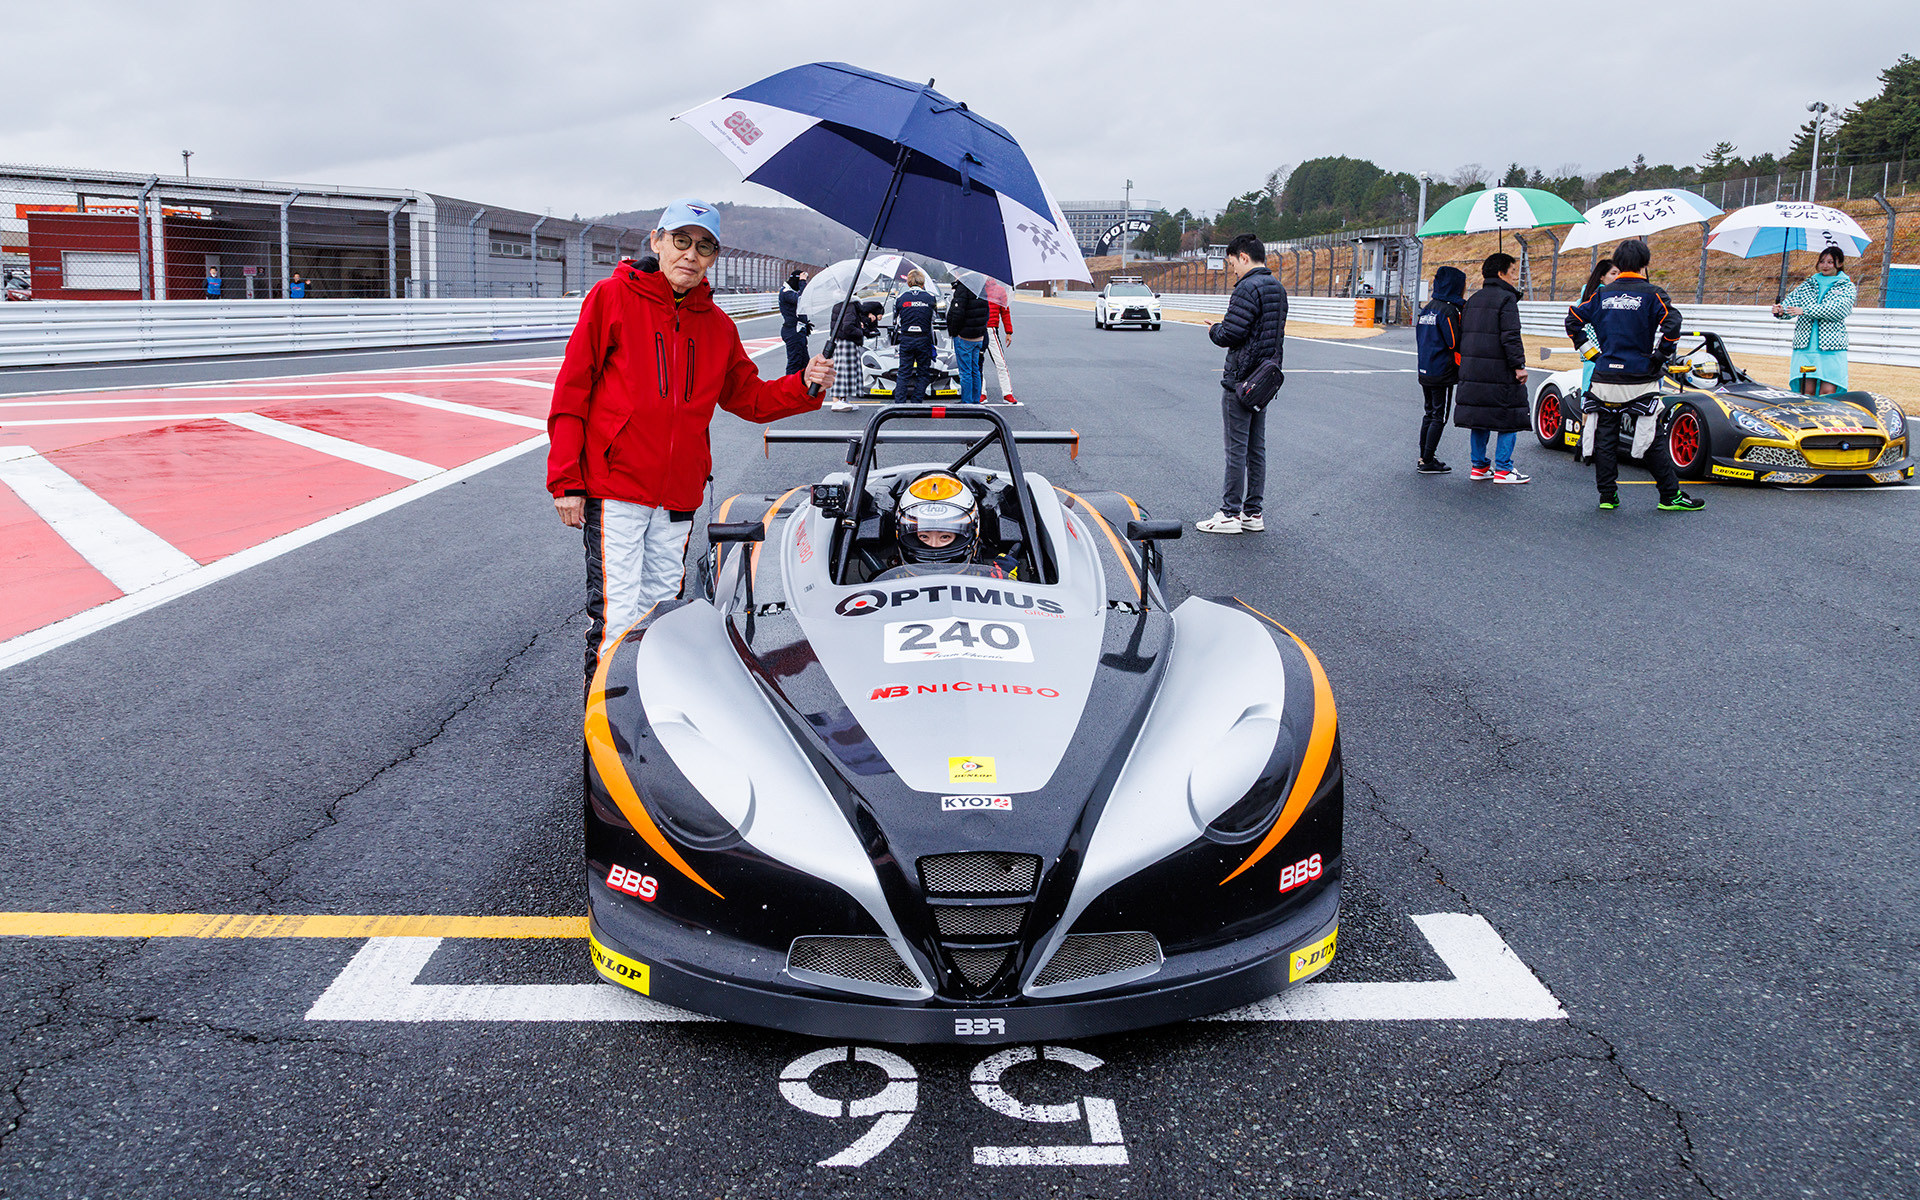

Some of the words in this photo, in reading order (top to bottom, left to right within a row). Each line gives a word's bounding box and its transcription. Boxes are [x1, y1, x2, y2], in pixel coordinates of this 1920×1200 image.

[1601, 195, 1676, 219] 男のロマンを
[1101, 220, 1153, 246] POTEN
[1719, 467, 1752, 477] DUNLOP
[925, 504, 944, 513] Arai
[835, 585, 1065, 617] OPTIMUS
[1024, 609, 1067, 619] GROUP
[898, 620, 1020, 652] 240
[917, 681, 1060, 698] NICHIBO
[606, 864, 659, 902] BBS
[1279, 853, 1323, 893] BBS
[591, 942, 642, 981] UNLOP
[1308, 941, 1336, 966] DUN
